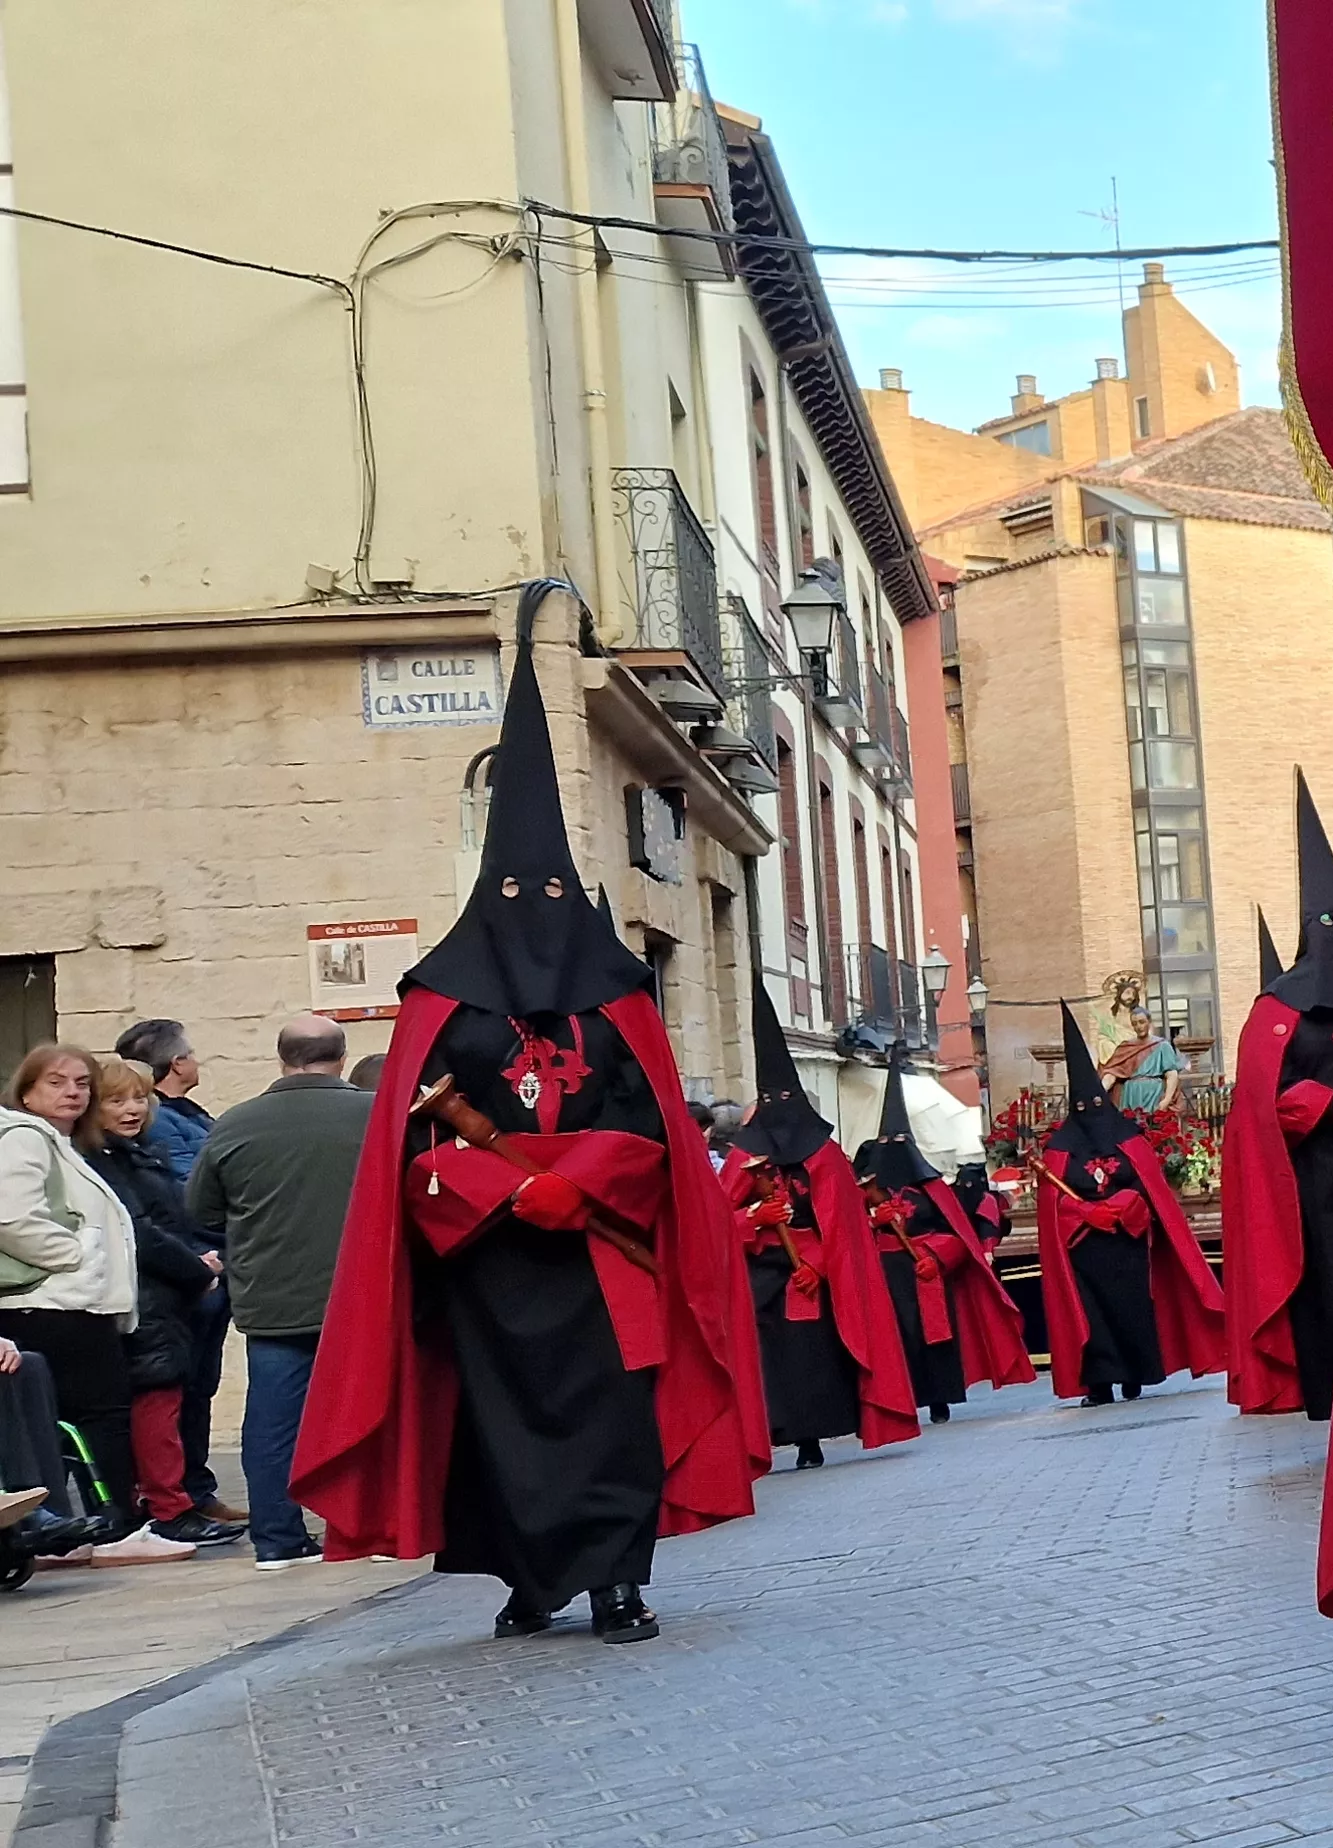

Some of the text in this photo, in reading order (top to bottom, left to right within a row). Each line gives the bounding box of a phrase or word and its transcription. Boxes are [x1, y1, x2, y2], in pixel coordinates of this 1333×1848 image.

[411, 659, 476, 678] CALLE
[374, 690, 493, 716] CASTILLA
[325, 922, 399, 936] Calle de CASTILLA
